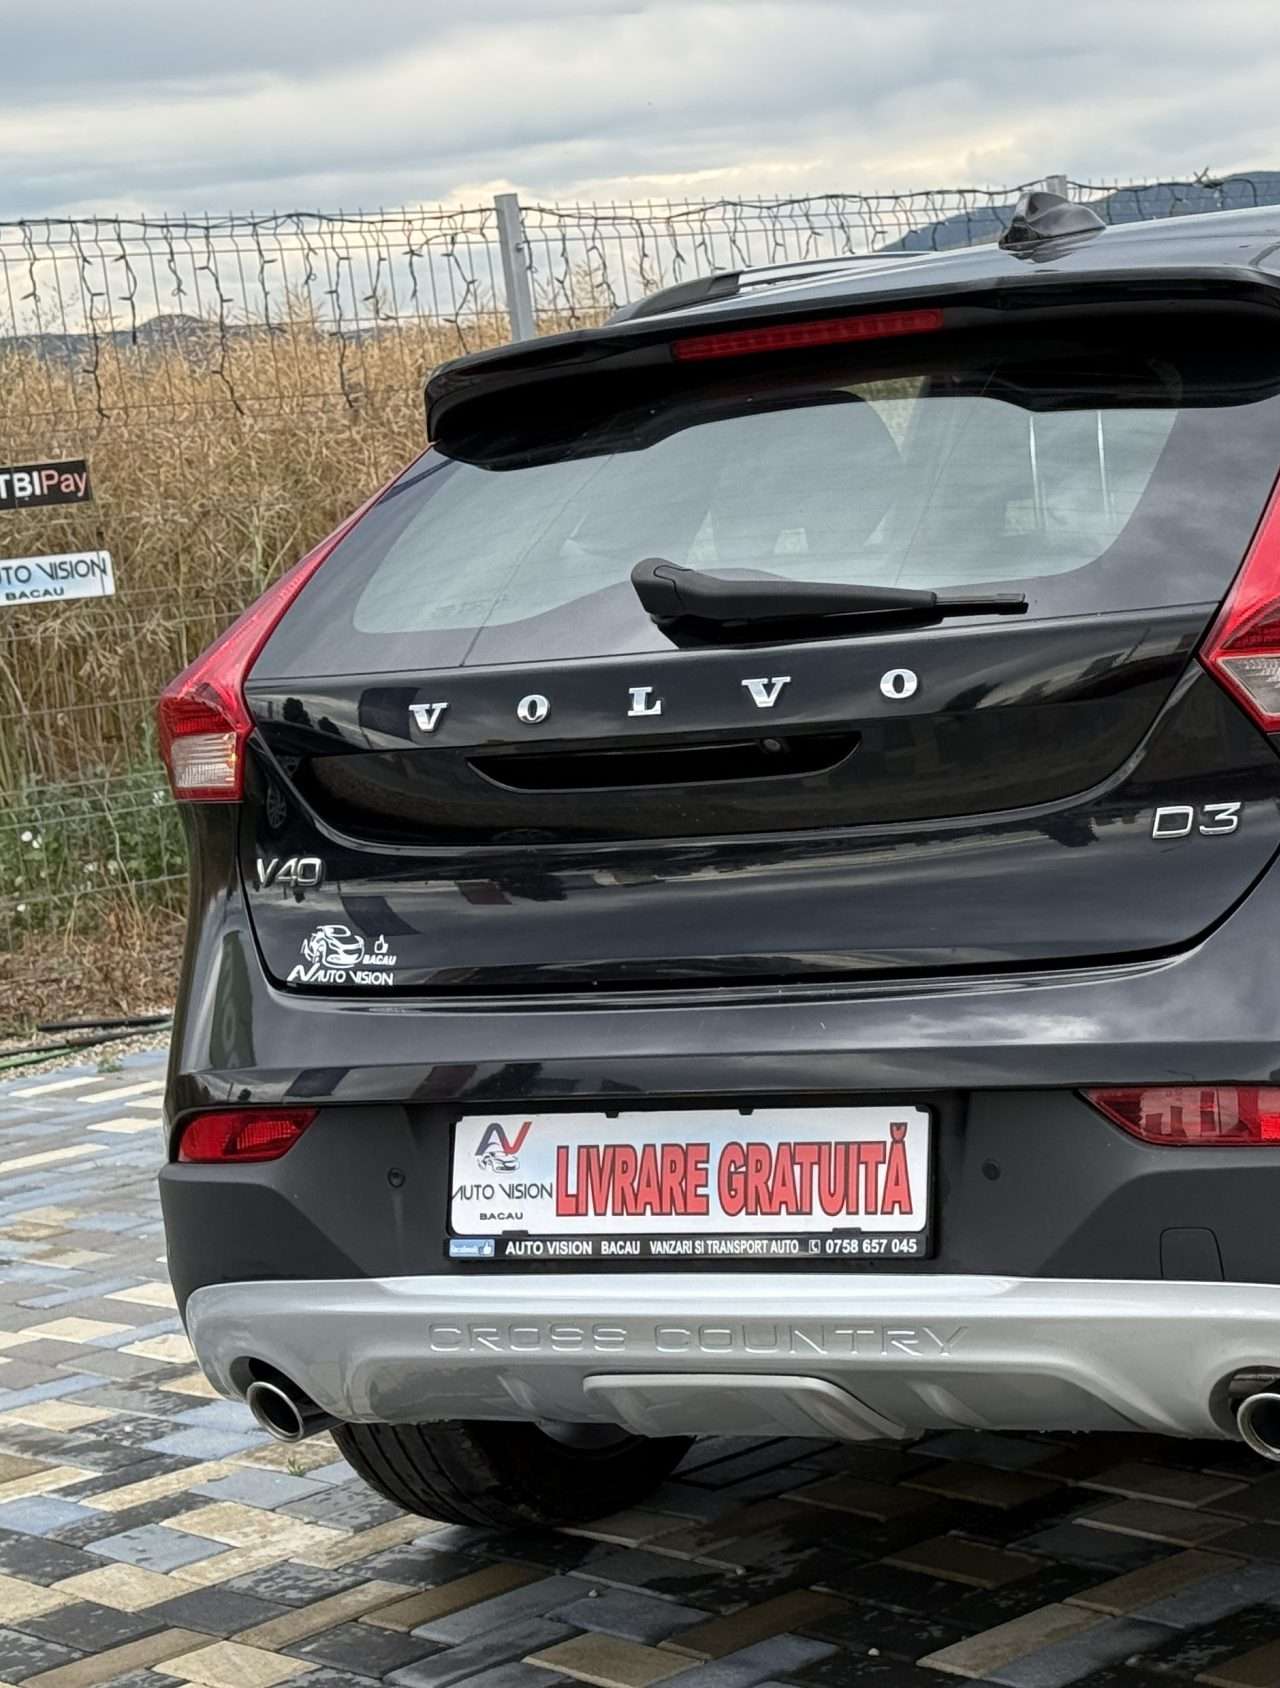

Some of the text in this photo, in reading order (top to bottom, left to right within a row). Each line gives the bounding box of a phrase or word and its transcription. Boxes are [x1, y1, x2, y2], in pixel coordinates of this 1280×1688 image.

[35, 558, 107, 581] VISION
[5, 587, 65, 601] BACAU
[409, 668, 918, 733] VOLVO
[1152, 801, 1242, 839] D3
[256, 857, 323, 887] V40
[362, 954, 397, 965] BACAU
[349, 970, 394, 986] VISION
[556, 1122, 914, 1217] LIVRARE GRATUITĂ
[451, 1182, 553, 1200] AUTO VISION
[479, 1212, 524, 1221] BACAU
[505, 1238, 918, 1256] AUTO VISION BACAU VANZARI SI TRANSPORT AUTO 0758 657 045
[429, 1322, 969, 1357] CROSS COUNTRY
